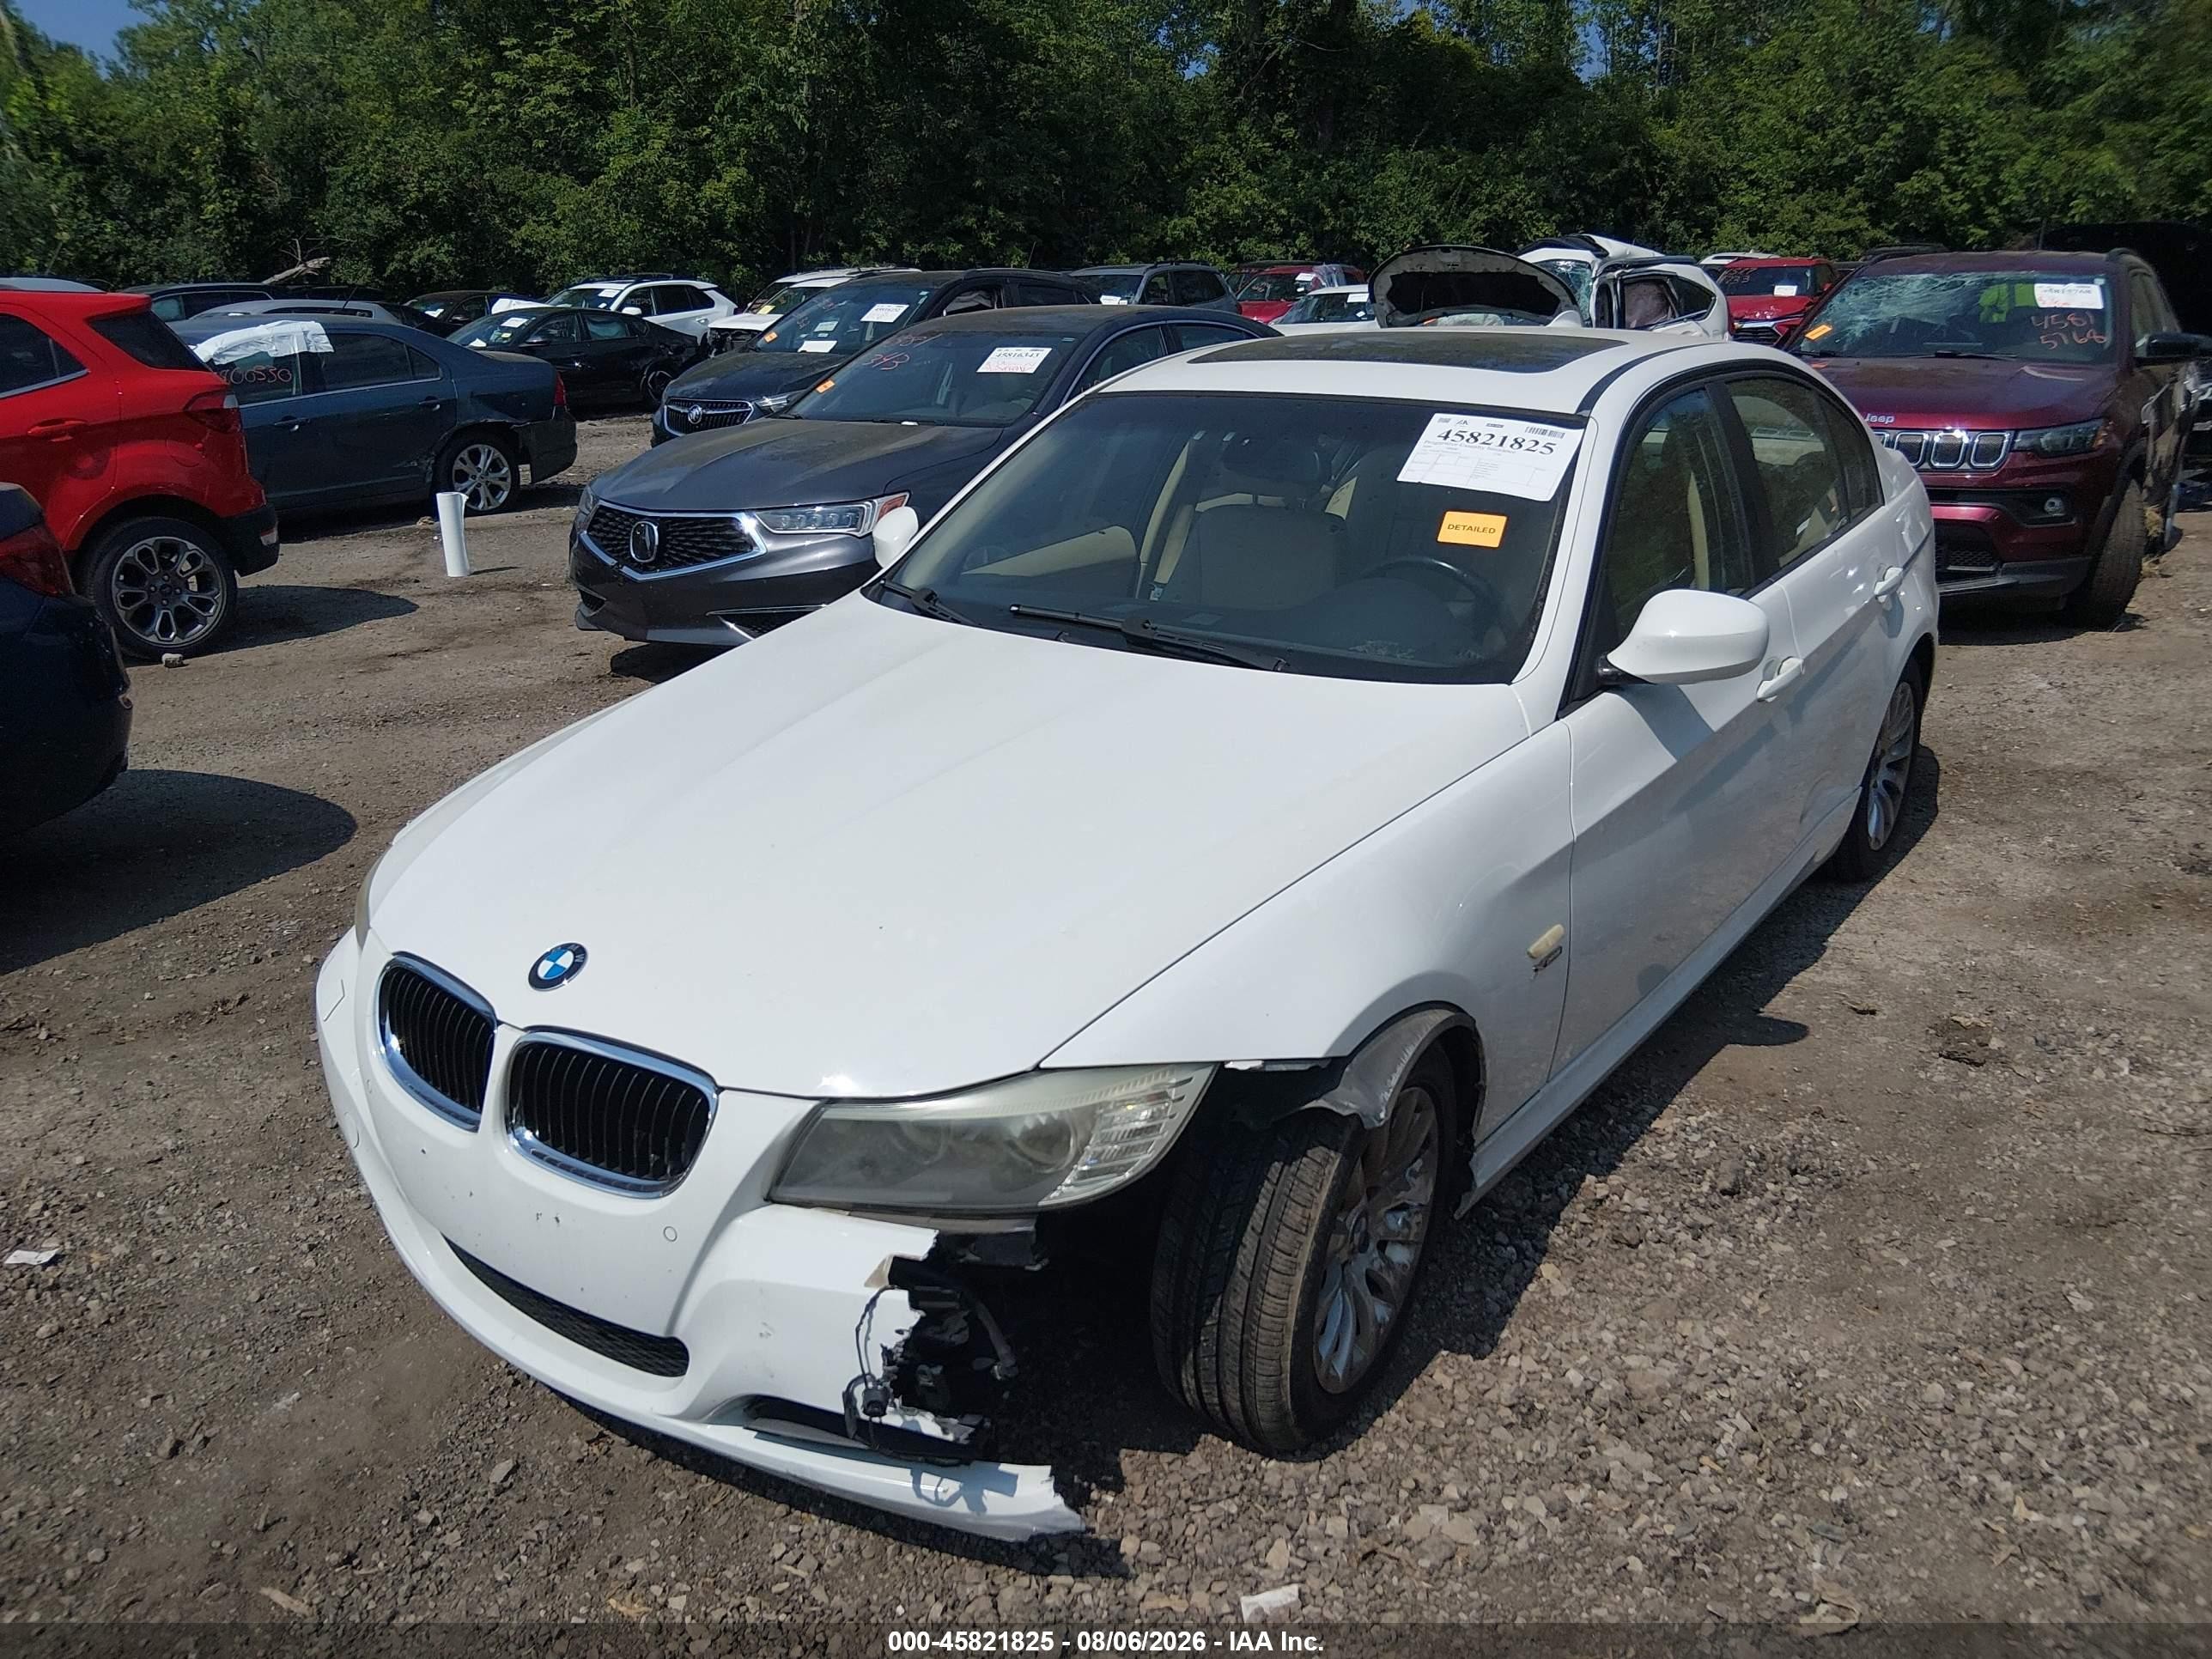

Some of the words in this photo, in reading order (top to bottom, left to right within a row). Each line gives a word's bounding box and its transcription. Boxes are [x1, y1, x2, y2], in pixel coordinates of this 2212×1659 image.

[1865, 413, 1895, 424] Jeep
[1437, 428, 1558, 456] 45821825
[1447, 523, 1497, 535] DETAILED
